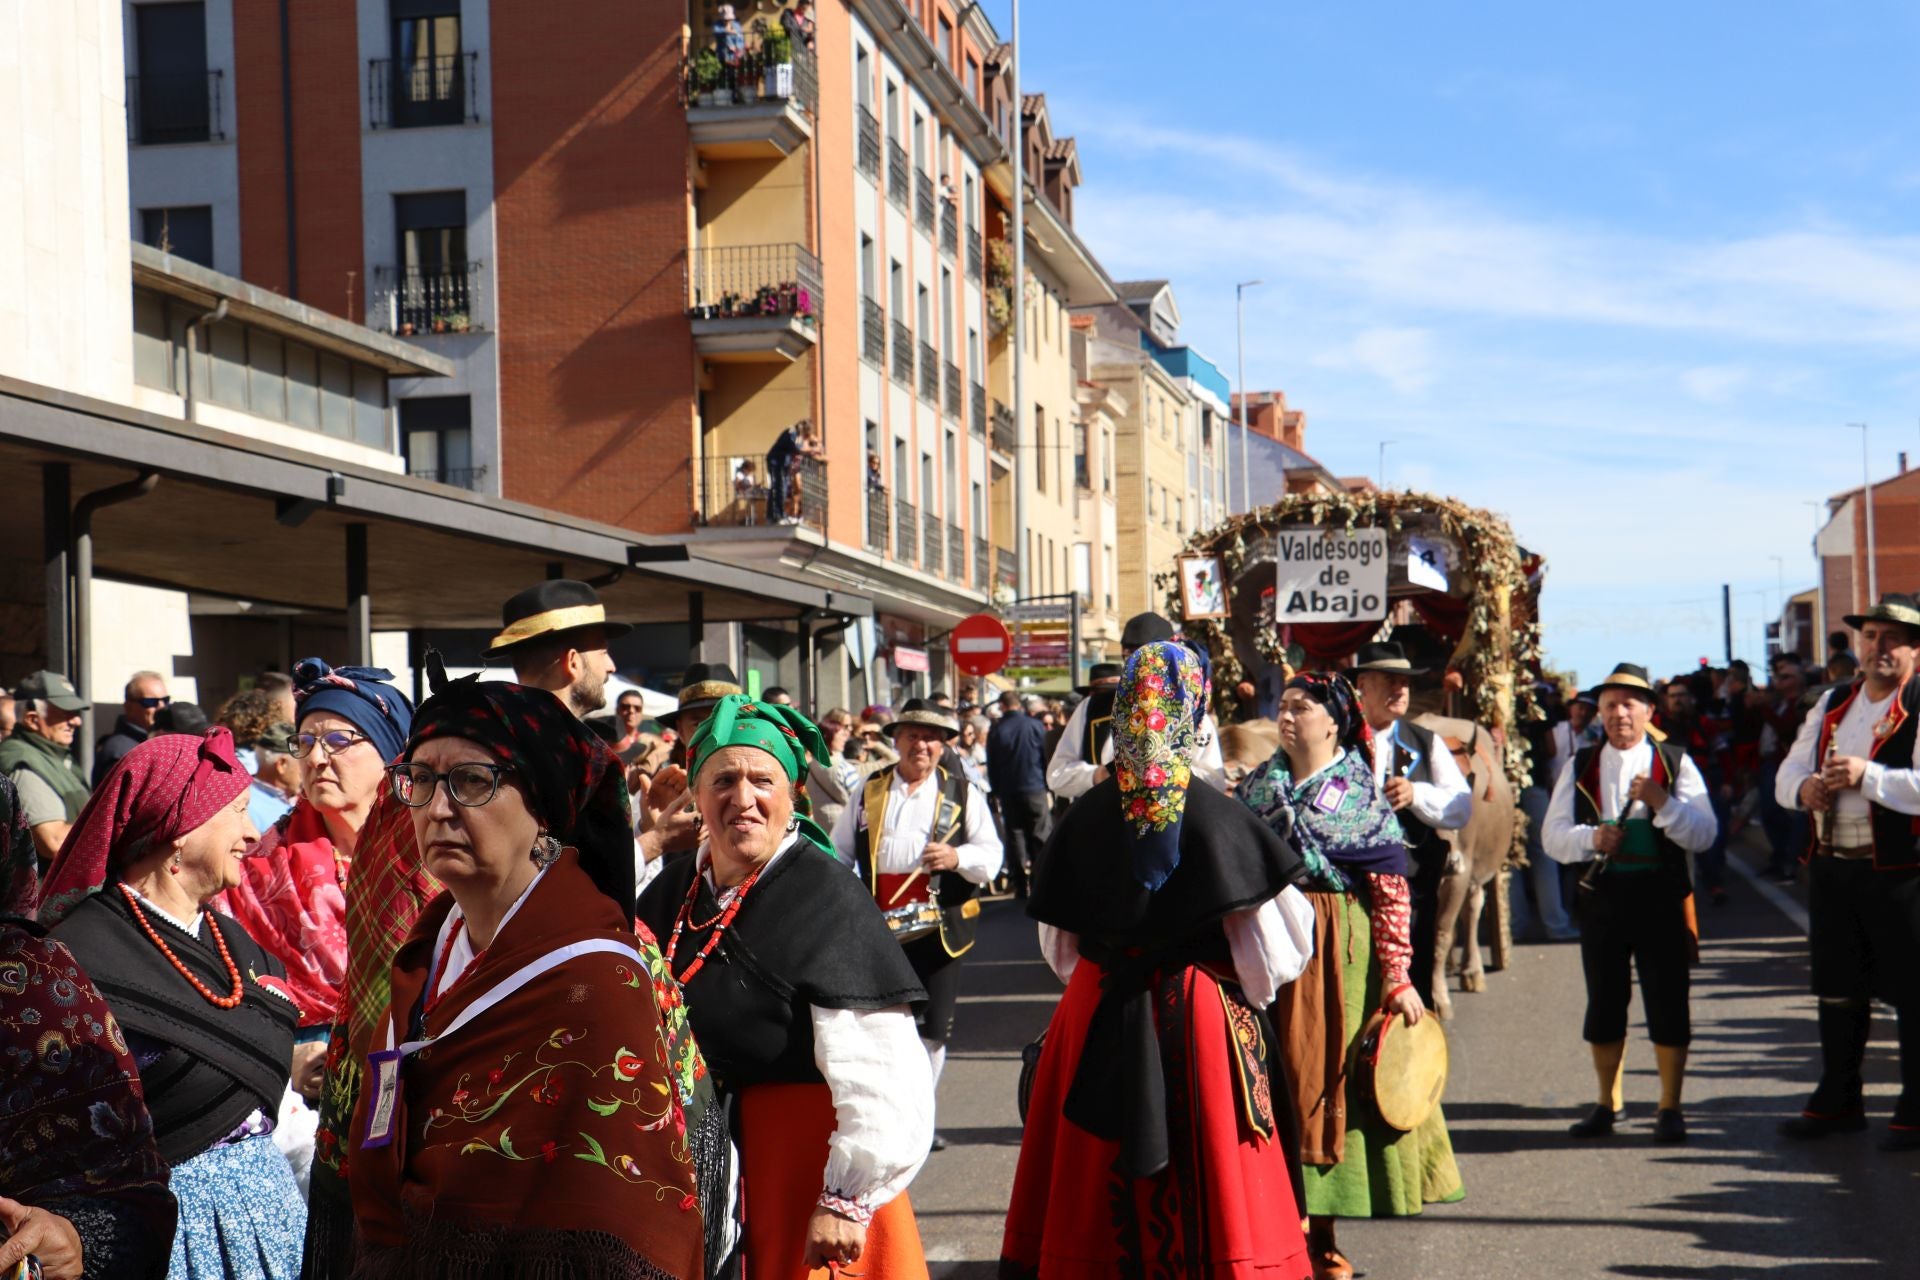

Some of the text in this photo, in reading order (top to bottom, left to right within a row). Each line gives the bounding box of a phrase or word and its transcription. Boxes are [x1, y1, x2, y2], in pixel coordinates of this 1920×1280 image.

[1281, 535, 1382, 566] Valdesogo
[1420, 549, 1437, 567] 4
[1319, 565, 1350, 585] de
[1286, 590, 1379, 617] Abajo
